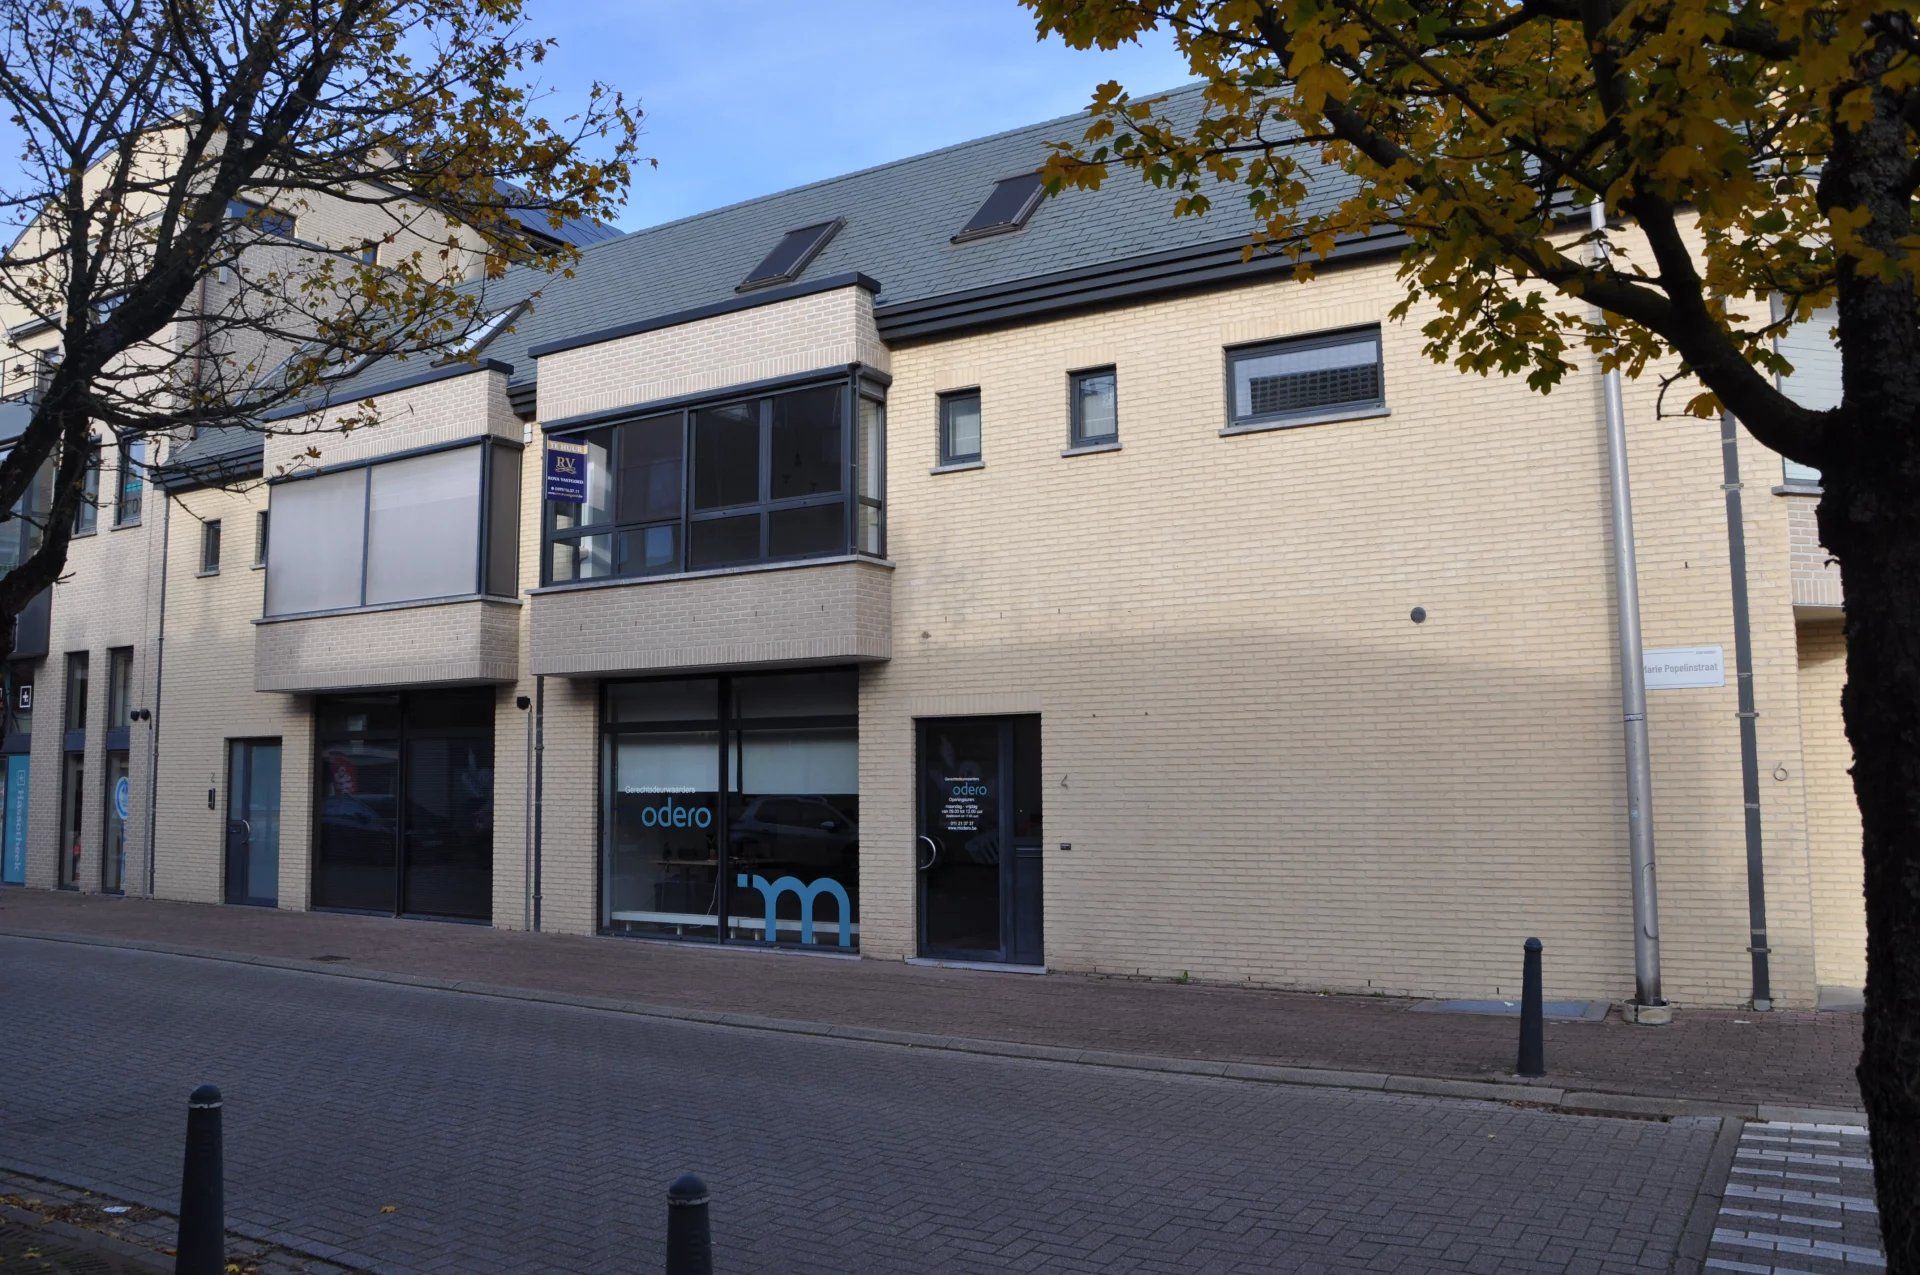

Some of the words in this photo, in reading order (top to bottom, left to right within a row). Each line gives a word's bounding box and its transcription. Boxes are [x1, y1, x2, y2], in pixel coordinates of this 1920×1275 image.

[556, 456, 576, 469] RV
[1665, 663, 1719, 675] Popelinstraat
[953, 782, 987, 795] odero
[641, 796, 712, 828] odero
